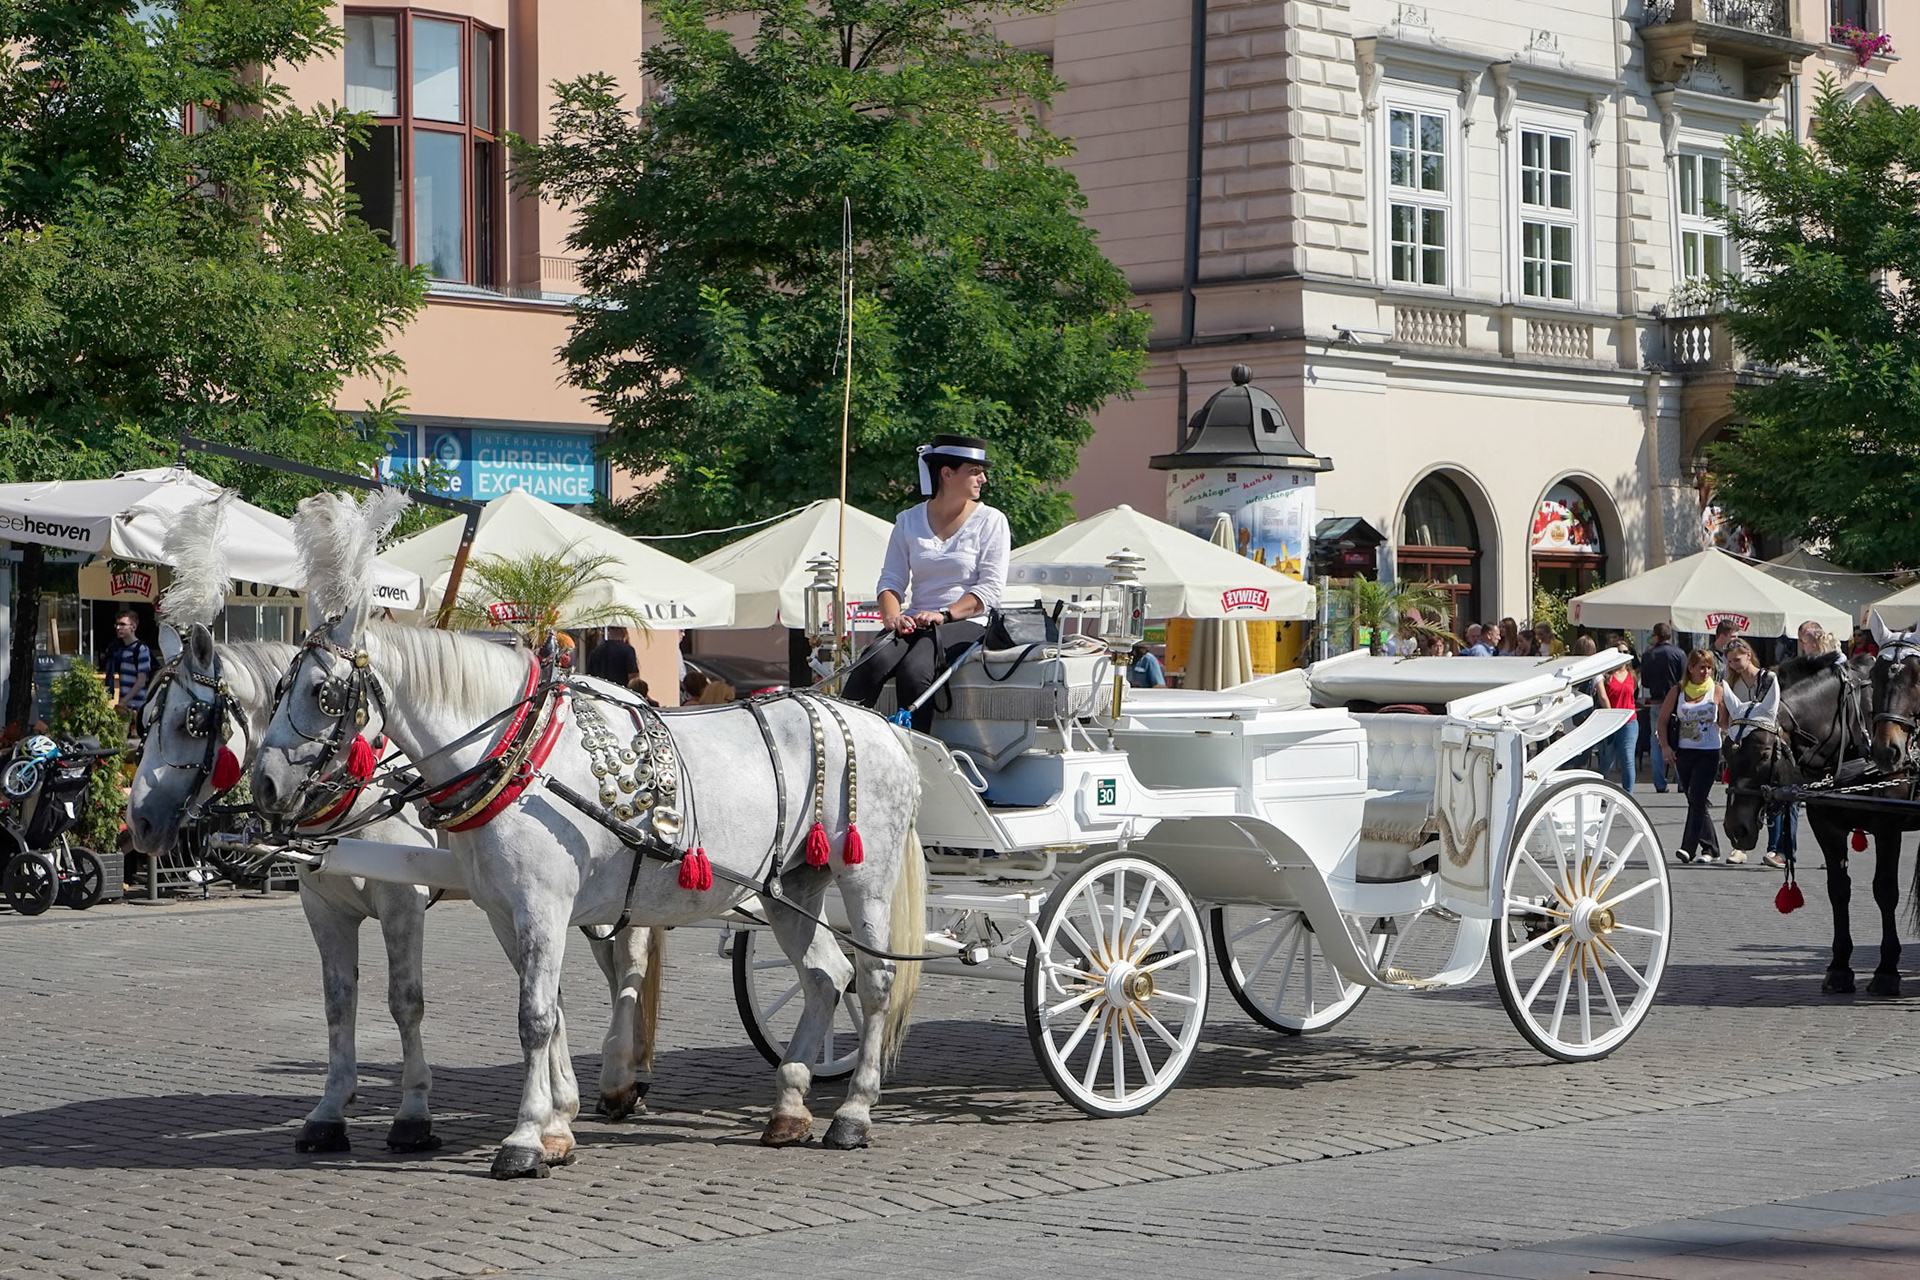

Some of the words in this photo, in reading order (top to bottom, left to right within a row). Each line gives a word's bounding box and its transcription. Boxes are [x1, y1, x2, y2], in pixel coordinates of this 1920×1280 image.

[478, 436, 591, 450] INTERNATIONAL
[478, 448, 589, 473] CURRENCY
[478, 472, 590, 497] EXCHANGE
[1226, 590, 1265, 605] ŻYWIEC
[1099, 788, 1114, 803] 30
